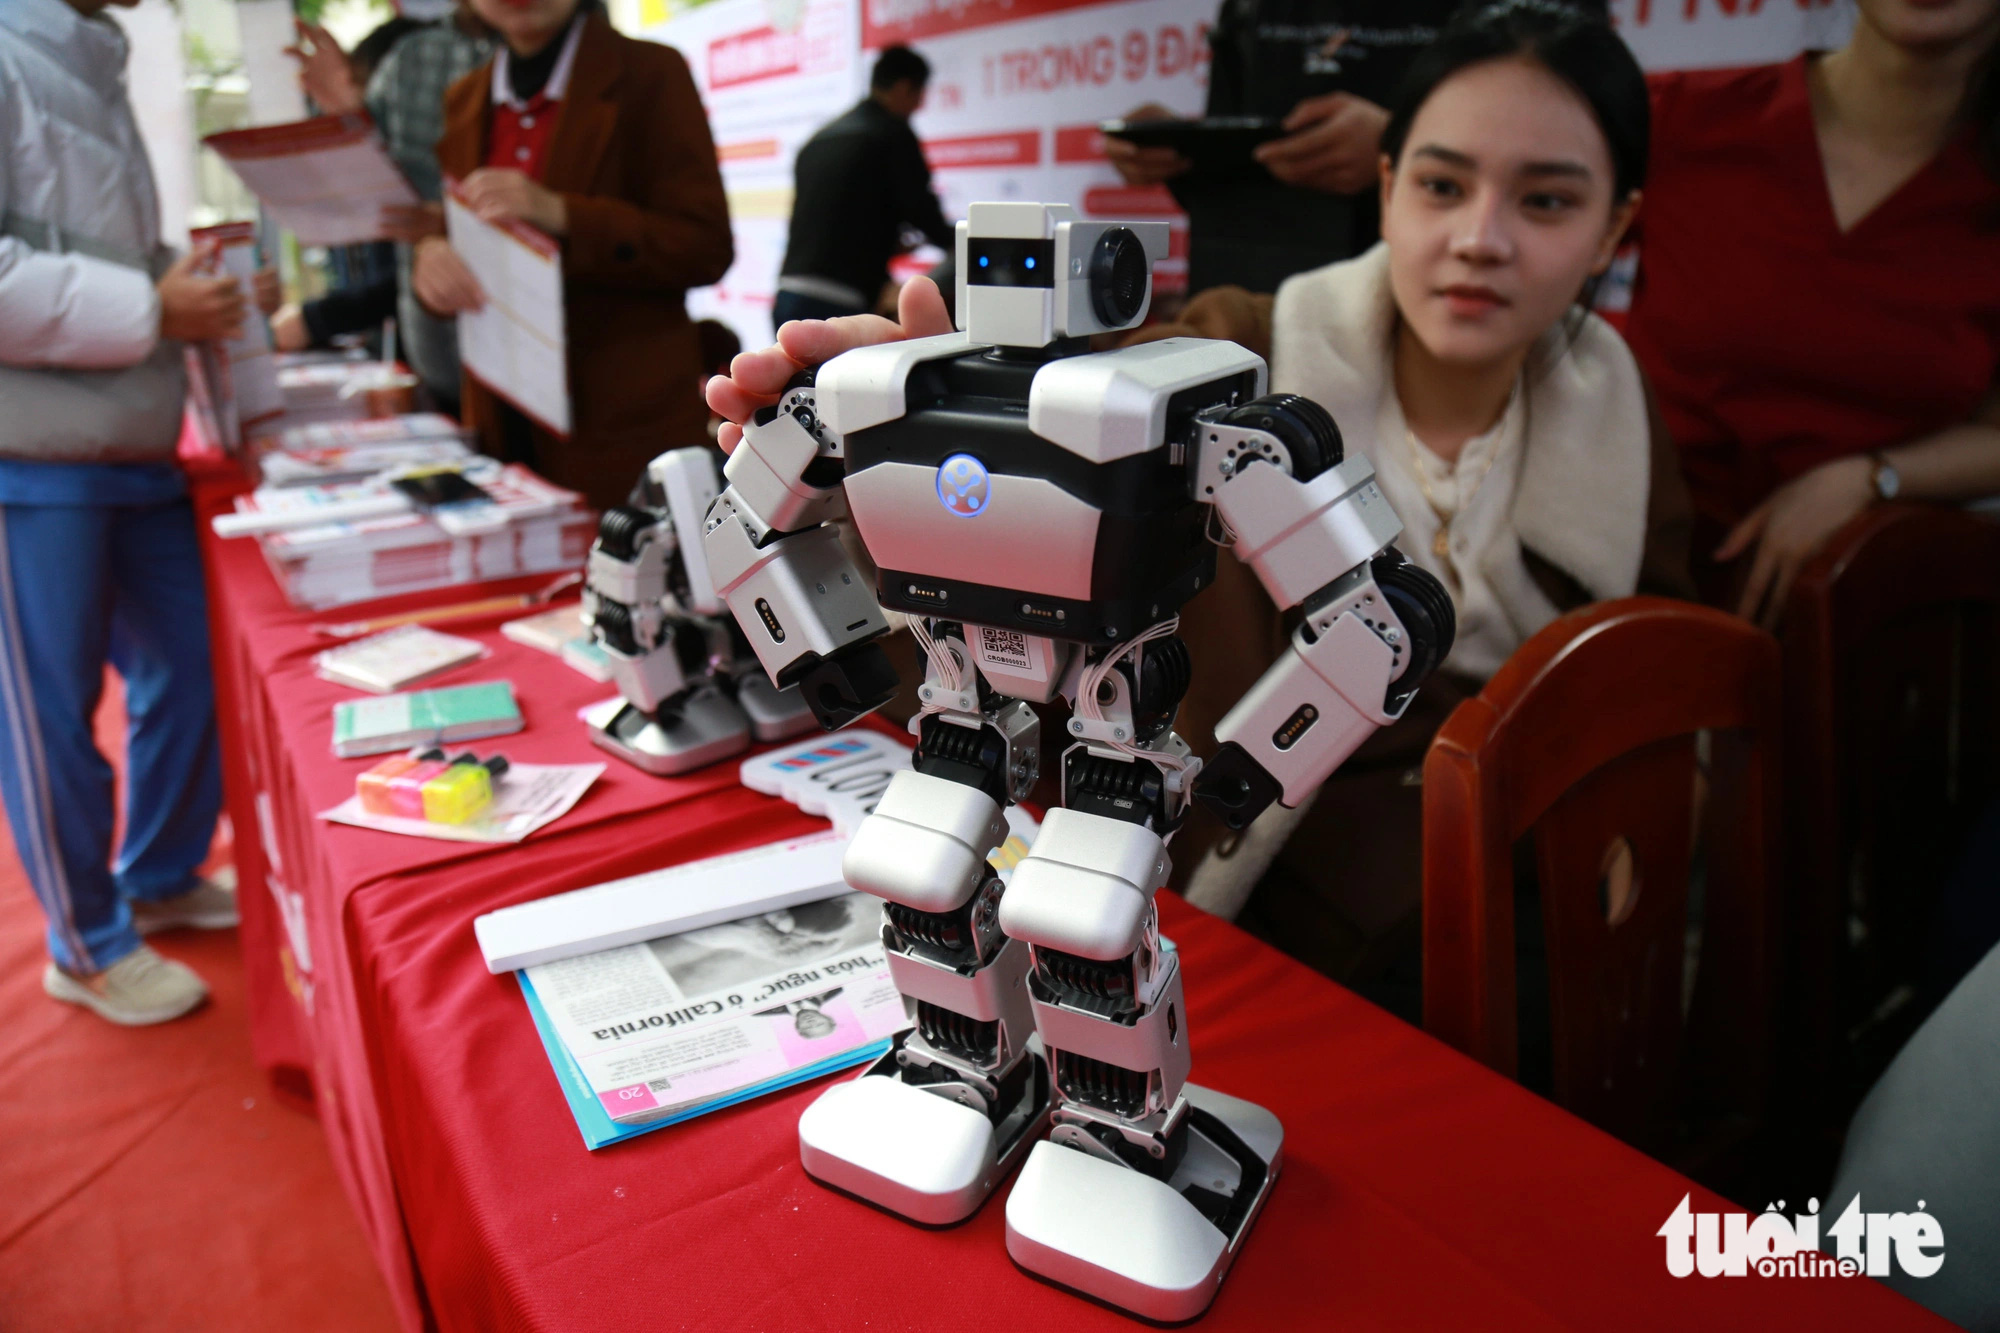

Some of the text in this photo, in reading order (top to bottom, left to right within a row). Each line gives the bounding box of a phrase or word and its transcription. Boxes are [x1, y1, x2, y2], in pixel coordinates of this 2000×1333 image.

[1001, 35, 1115, 94] TRONG
[1122, 28, 1149, 82] 9
[592, 999, 724, 1041] California
[618, 1086, 645, 1101] 20
